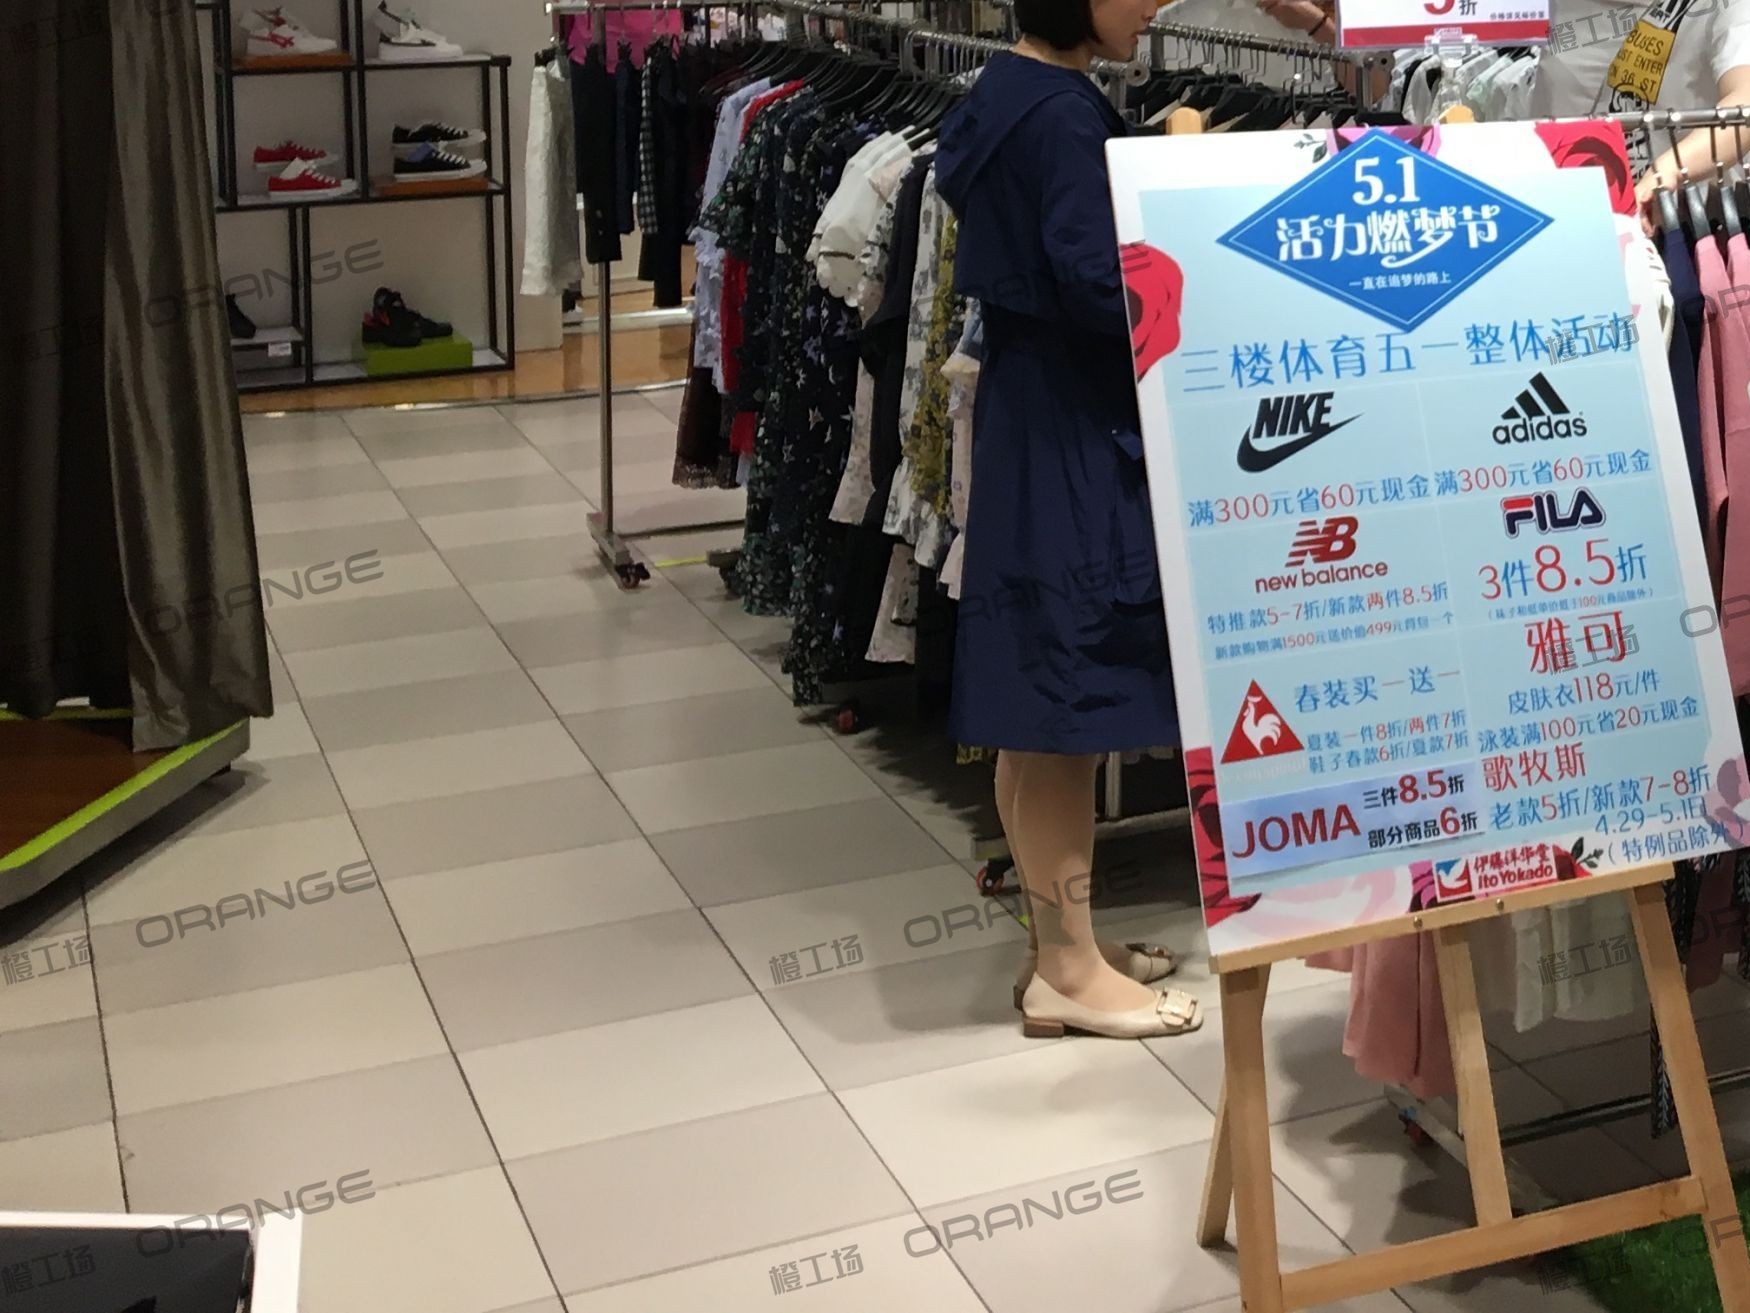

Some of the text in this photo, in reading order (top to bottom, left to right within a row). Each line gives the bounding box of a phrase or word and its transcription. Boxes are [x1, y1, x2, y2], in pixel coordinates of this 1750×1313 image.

[1633, 54, 1664, 76] ENTER
[1352, 156, 1421, 205] 5.1
[1276, 204, 1503, 268] 活力燃梦节
[1182, 312, 1635, 393] 三楼体育五一整体活动
[1253, 392, 1334, 439] NIKE
[1492, 414, 1588, 445] adidas
[1500, 486, 1606, 538] FILA
[1255, 560, 1389, 594] new balance
[1478, 538, 1648, 600] 3件8.5折
[1295, 665, 1461, 714] 春装买一送一
[1362, 769, 1465, 810] 三件8.5折
[1481, 742, 1587, 793] 歌牧斯
[1231, 804, 1361, 859] JOMA
[1367, 806, 1478, 850] 部分商品6折
